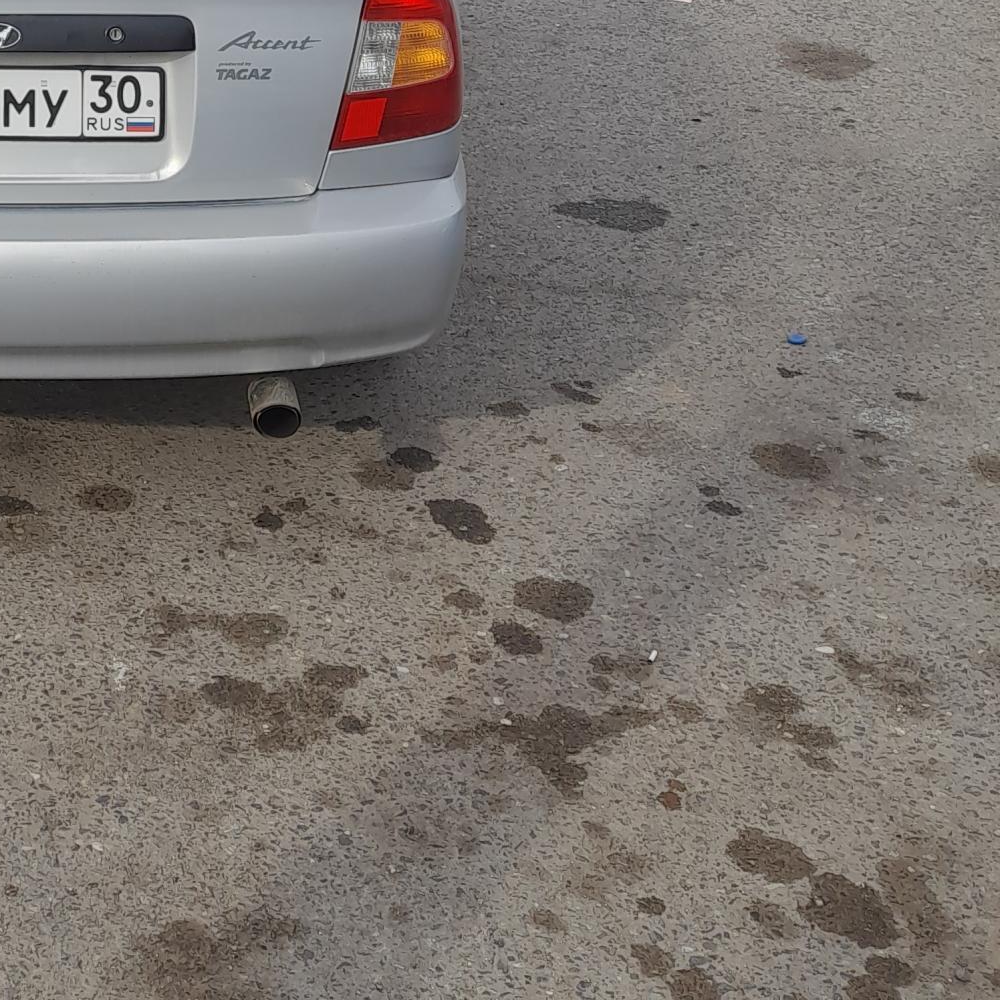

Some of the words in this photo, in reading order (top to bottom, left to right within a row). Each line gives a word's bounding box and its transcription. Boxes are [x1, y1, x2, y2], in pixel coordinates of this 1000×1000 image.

[217, 30, 322, 52] Accent
[216, 68, 272, 80] TAGAZ
[89, 75, 142, 114] 30
[86, 117, 125, 131] RUS
